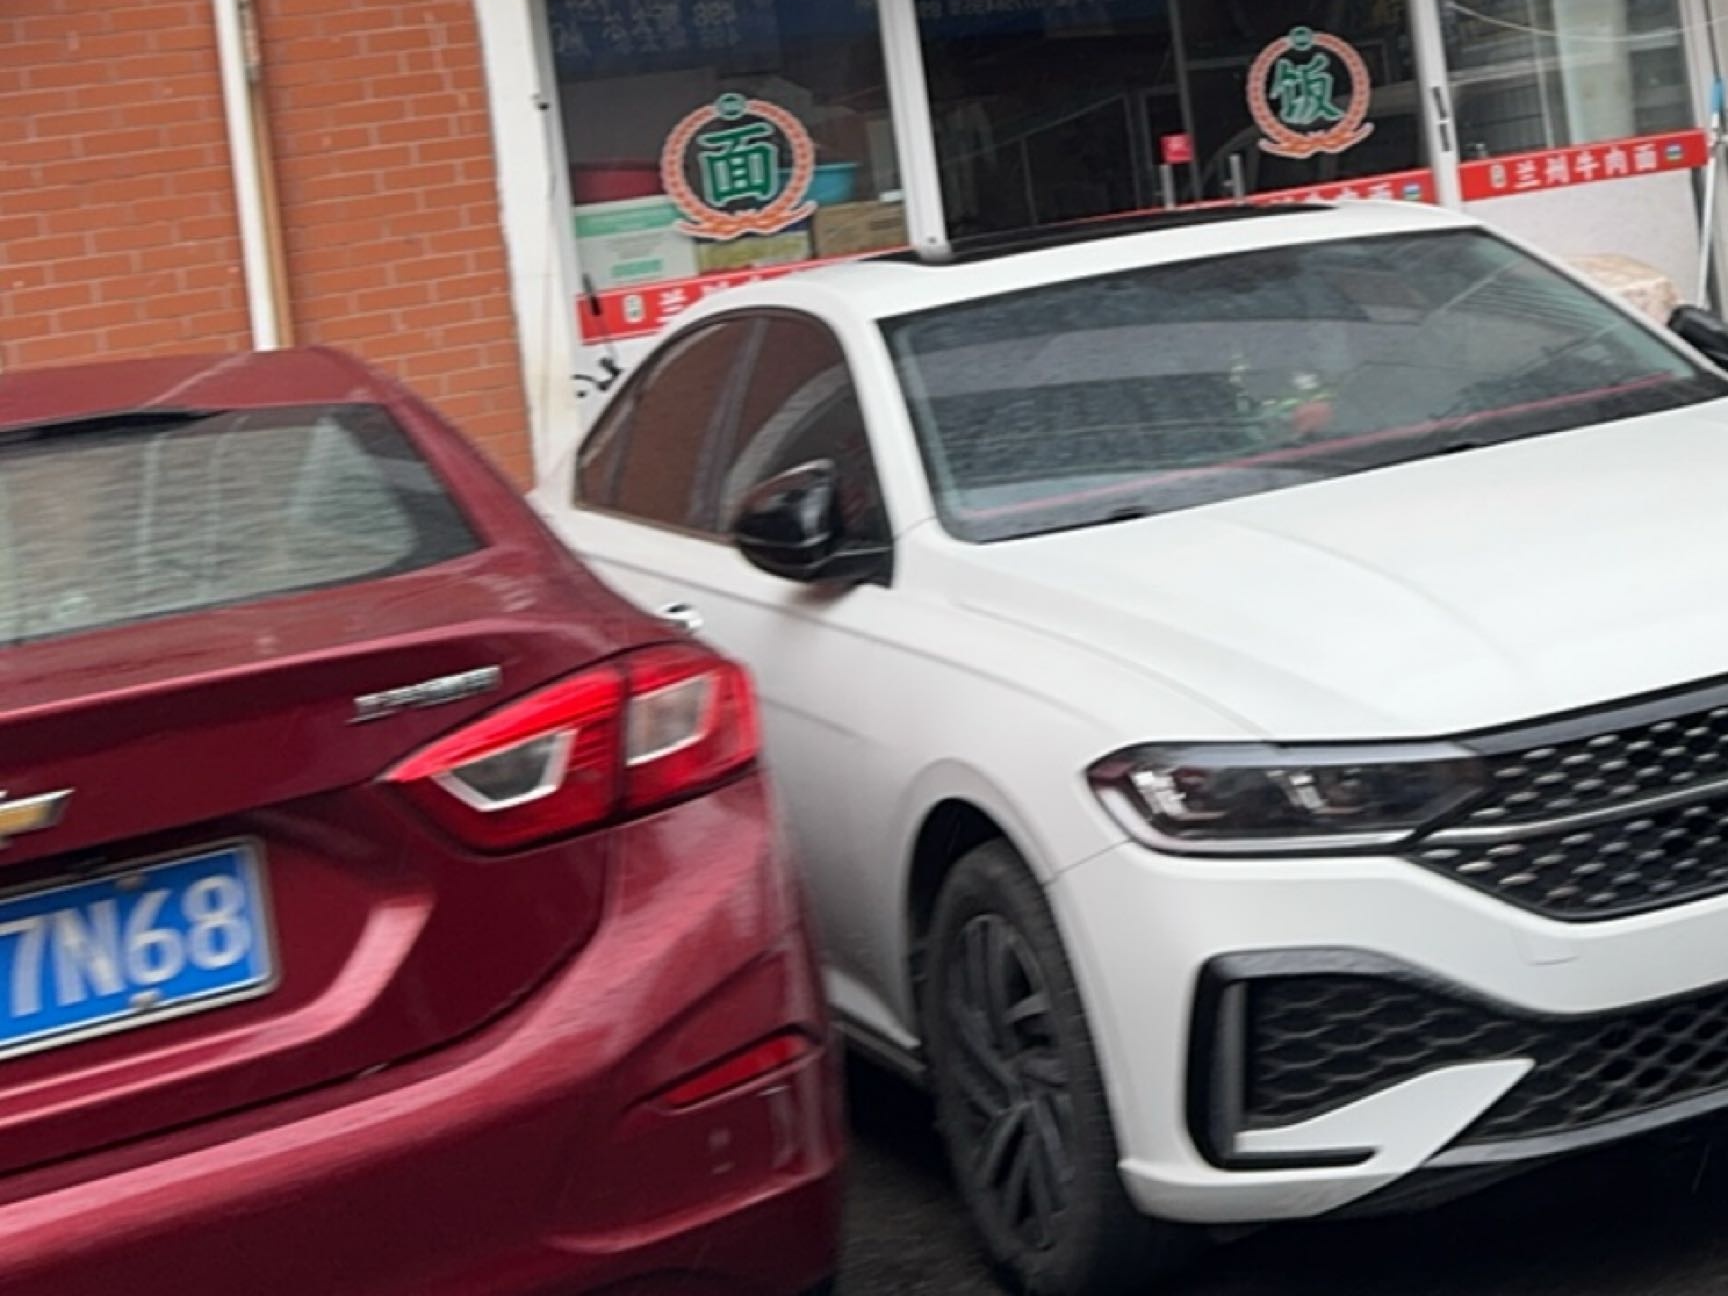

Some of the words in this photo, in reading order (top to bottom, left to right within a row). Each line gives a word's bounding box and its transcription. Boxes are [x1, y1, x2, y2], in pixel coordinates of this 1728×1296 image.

[1270, 52, 1346, 125] 饭
[699, 121, 777, 204] 面
[1514, 143, 1658, 189] 兰州牛肉面
[0, 875, 251, 1018] 7N68
